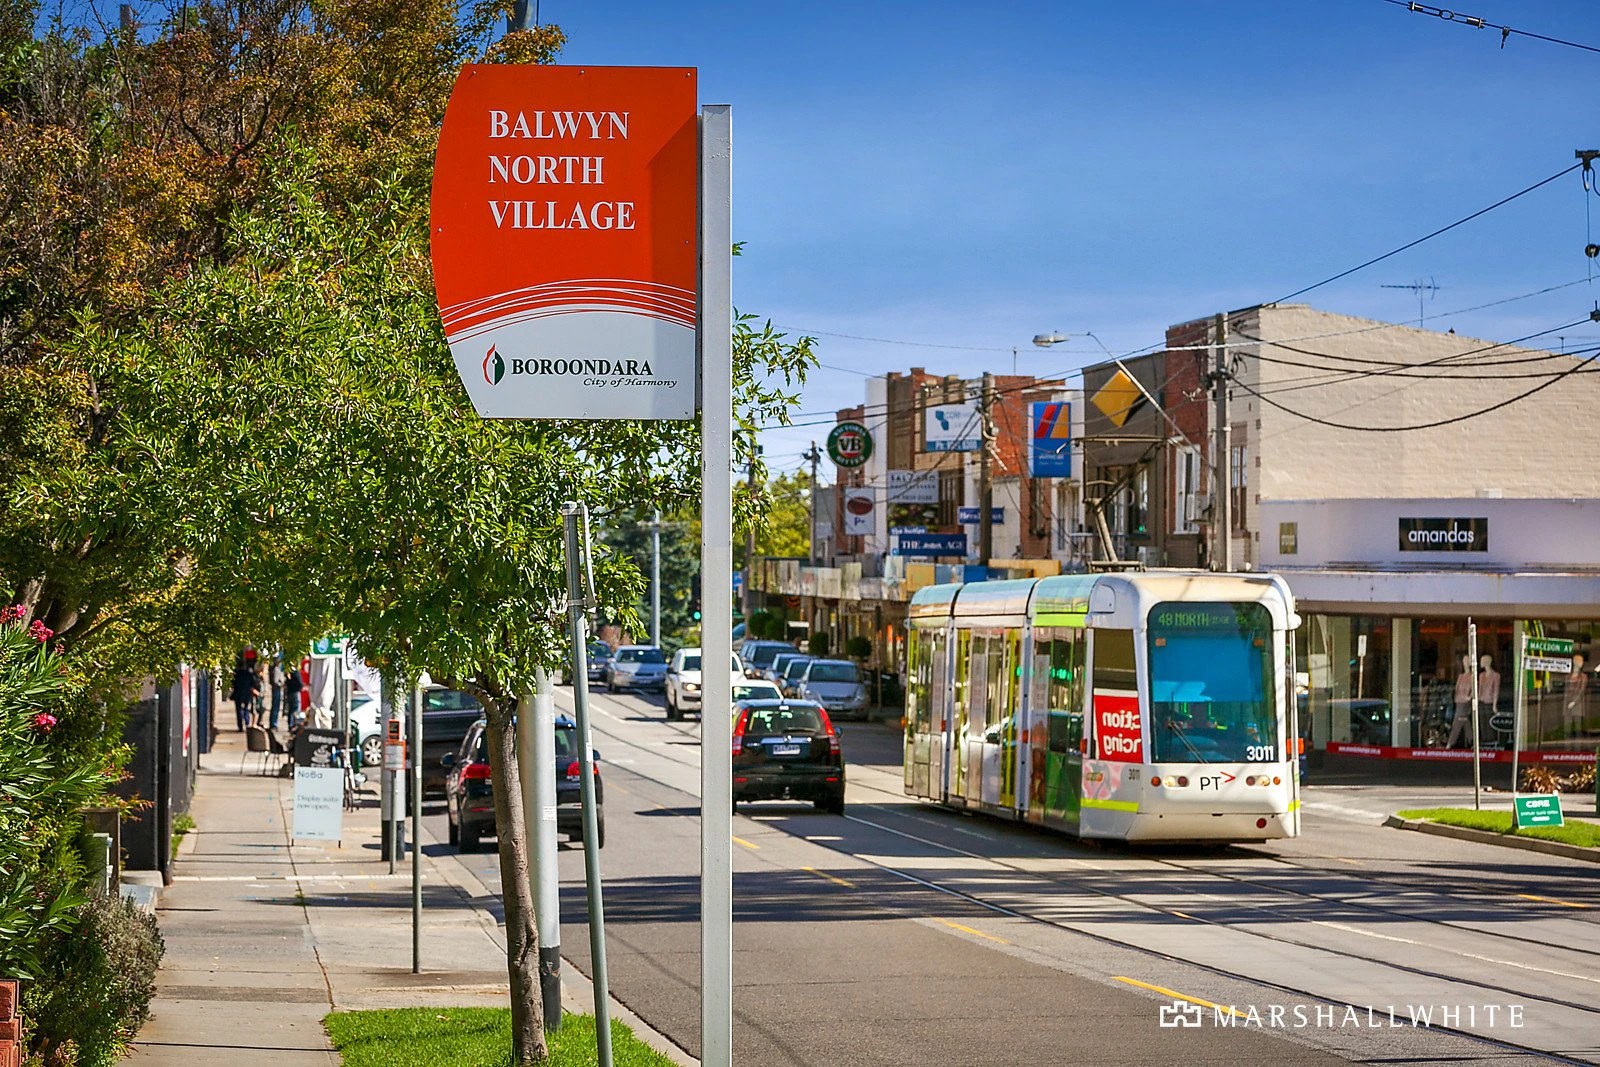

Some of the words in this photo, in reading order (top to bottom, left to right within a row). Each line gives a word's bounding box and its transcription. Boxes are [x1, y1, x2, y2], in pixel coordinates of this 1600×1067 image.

[488, 110, 630, 140] BALWYN
[488, 155, 605, 185] NORTH
[488, 200, 636, 230] VILLAGE
[511, 358, 653, 376] BOROONDARA
[583, 377, 607, 388] City
[610, 377, 625, 388] of
[624, 378, 677, 389] Harmony
[839, 437, 862, 452] VB
[1408, 520, 1474, 543] amandas
[901, 540, 921, 550] THE
[1158, 612, 1173, 626] 48
[1174, 612, 1209, 627] NORTH
[1246, 745, 1274, 762] 3011
[1200, 776, 1222, 791] PT
